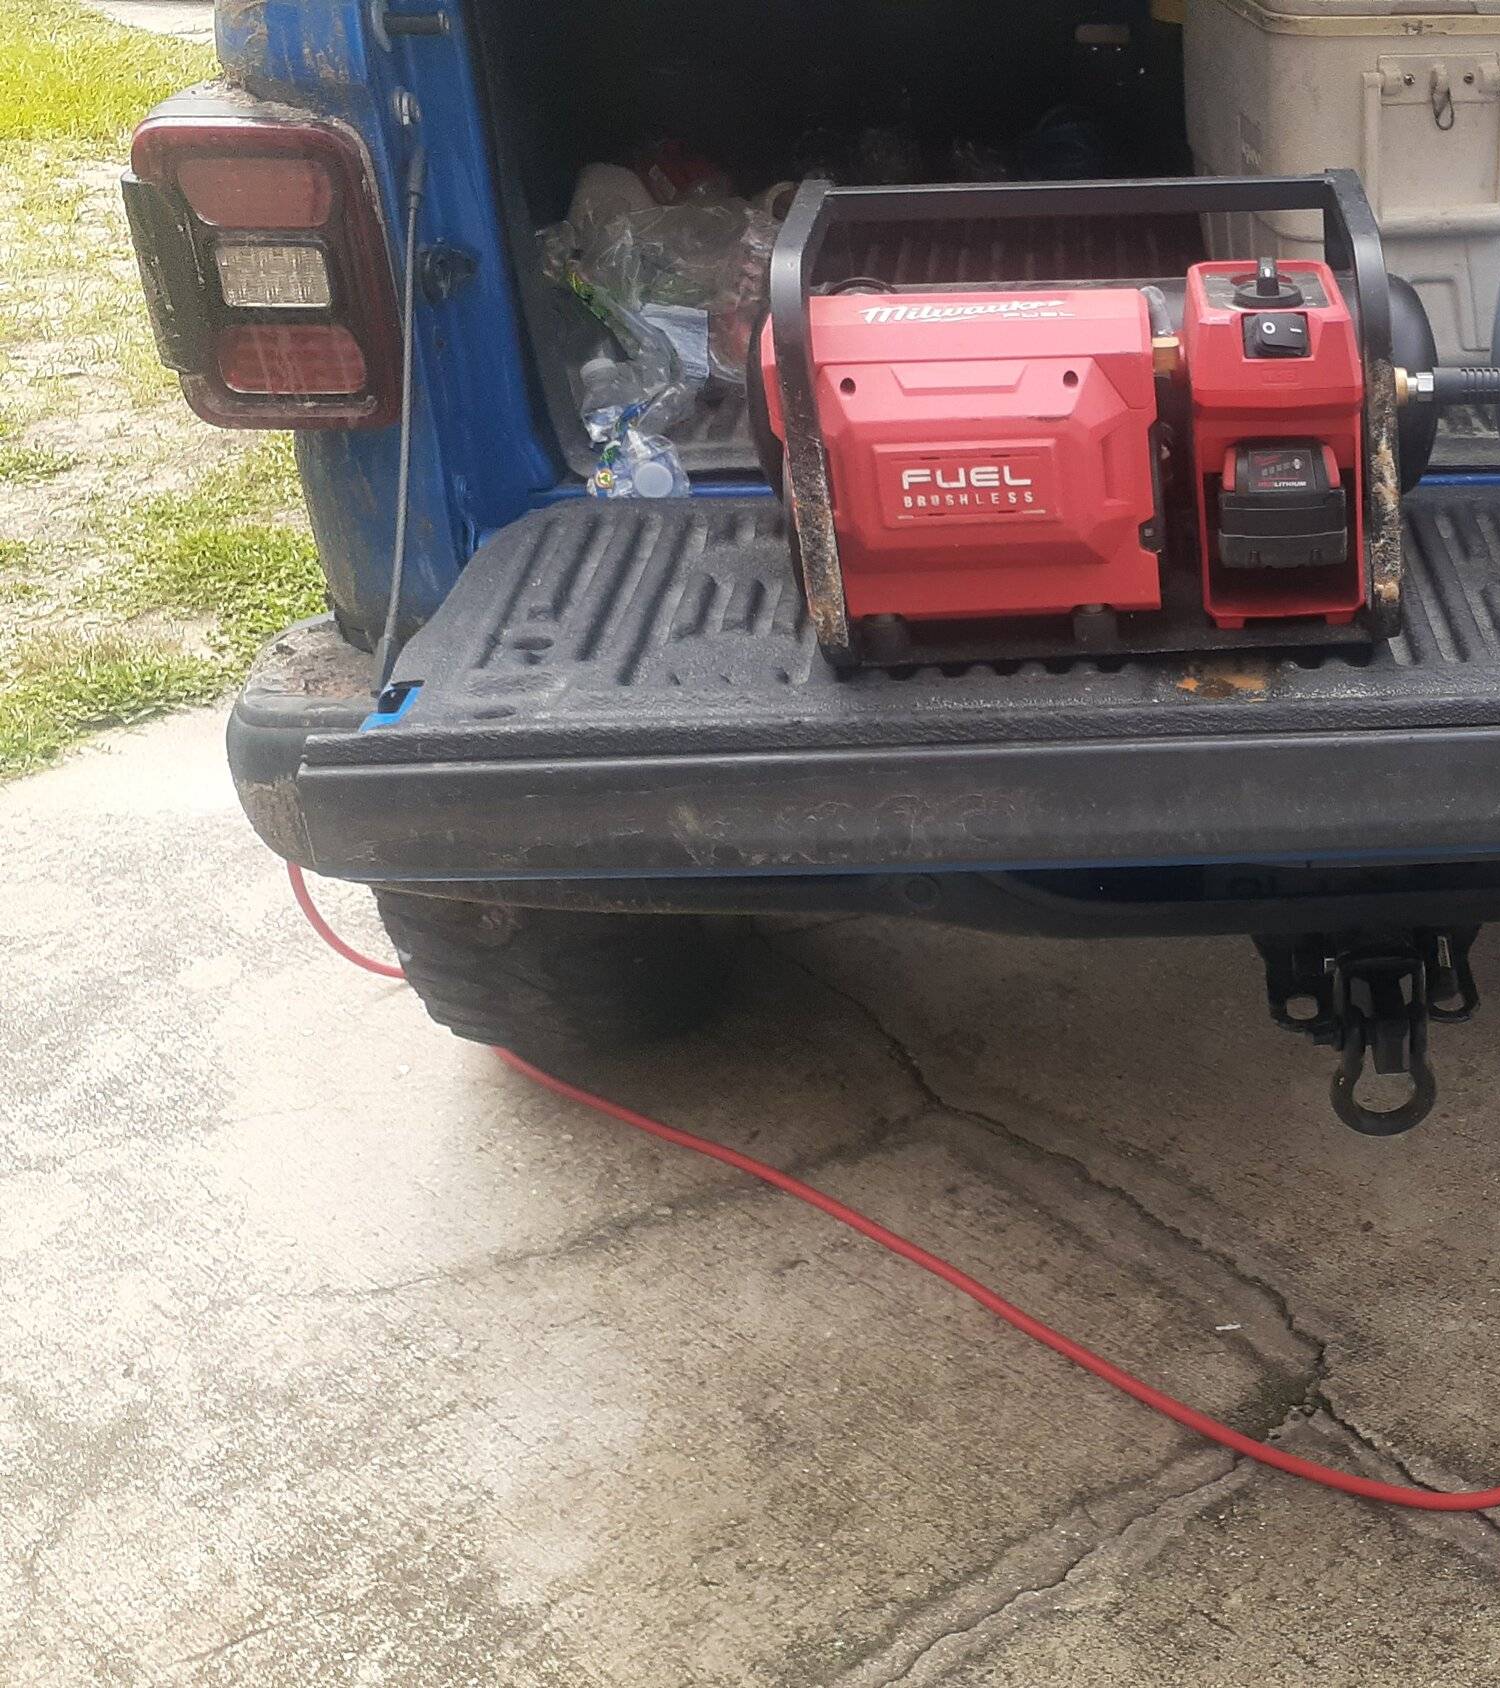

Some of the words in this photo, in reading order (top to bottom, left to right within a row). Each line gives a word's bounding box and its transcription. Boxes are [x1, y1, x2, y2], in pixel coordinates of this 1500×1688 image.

[859, 300, 1065, 325] Milwaukee
[902, 465, 1032, 490] FUEL
[903, 491, 1033, 508] BRUSHLESS
